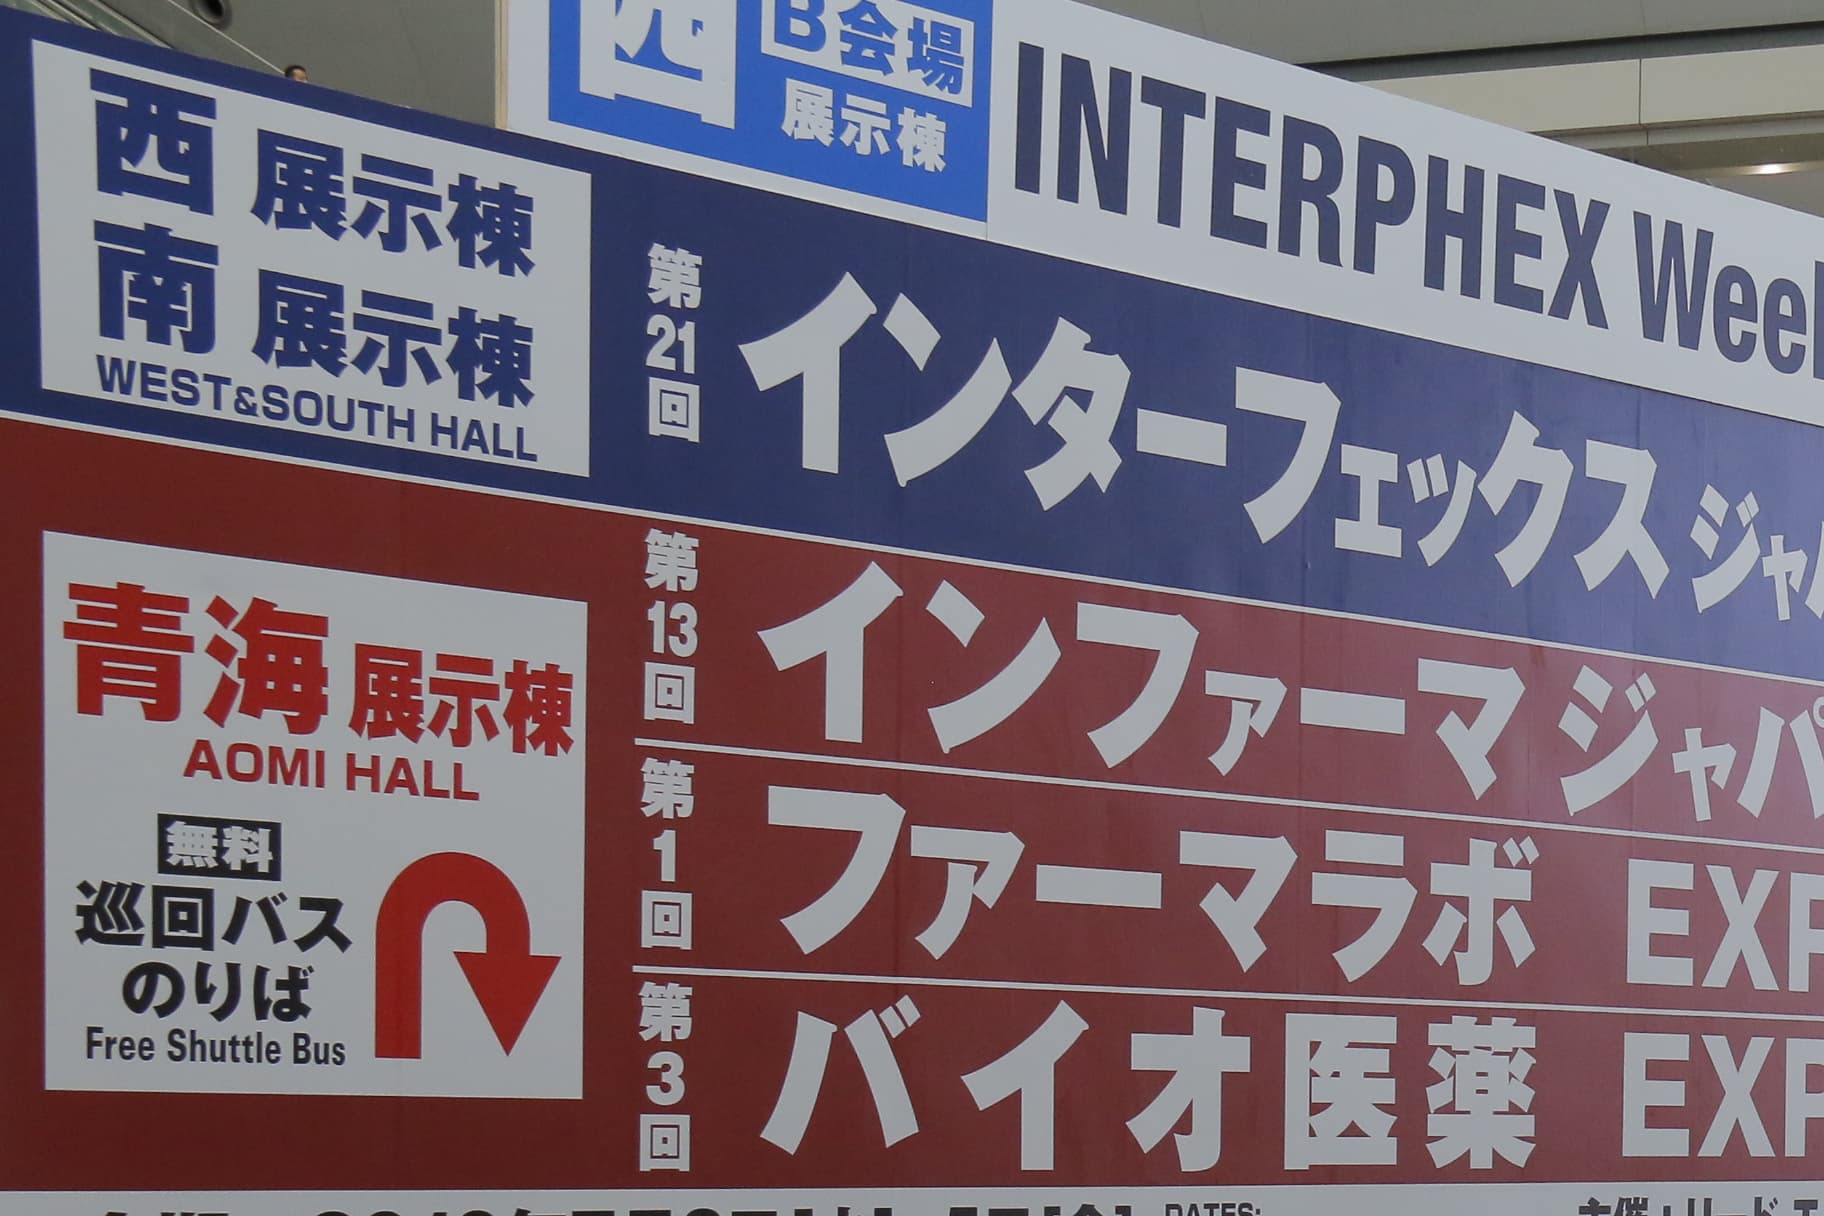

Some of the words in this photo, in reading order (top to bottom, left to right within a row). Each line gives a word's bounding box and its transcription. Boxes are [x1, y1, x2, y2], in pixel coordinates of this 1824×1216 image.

[774, 0, 965, 95] B会場
[781, 78, 947, 173] 展示棟
[1014, 41, 1611, 330] INTERPHEX
[96, 354, 416, 443] WEST&SOUTH
[430, 414, 538, 463] HALL
[738, 271, 1671, 599] インターフェックス
[757, 561, 1526, 800] インファーマ
[183, 739, 327, 790] AOMI
[345, 754, 480, 801] HALL
[166, 821, 274, 875] 無料
[767, 785, 1541, 988] ファーマラボ
[75, 879, 354, 955] 巡回バス
[122, 961, 314, 1023] のりば
[85, 1025, 156, 1063] Free
[166, 1027, 282, 1065] Shuttle
[292, 1032, 347, 1067] Bus
[759, 994, 1537, 1172] バイオ医薬
